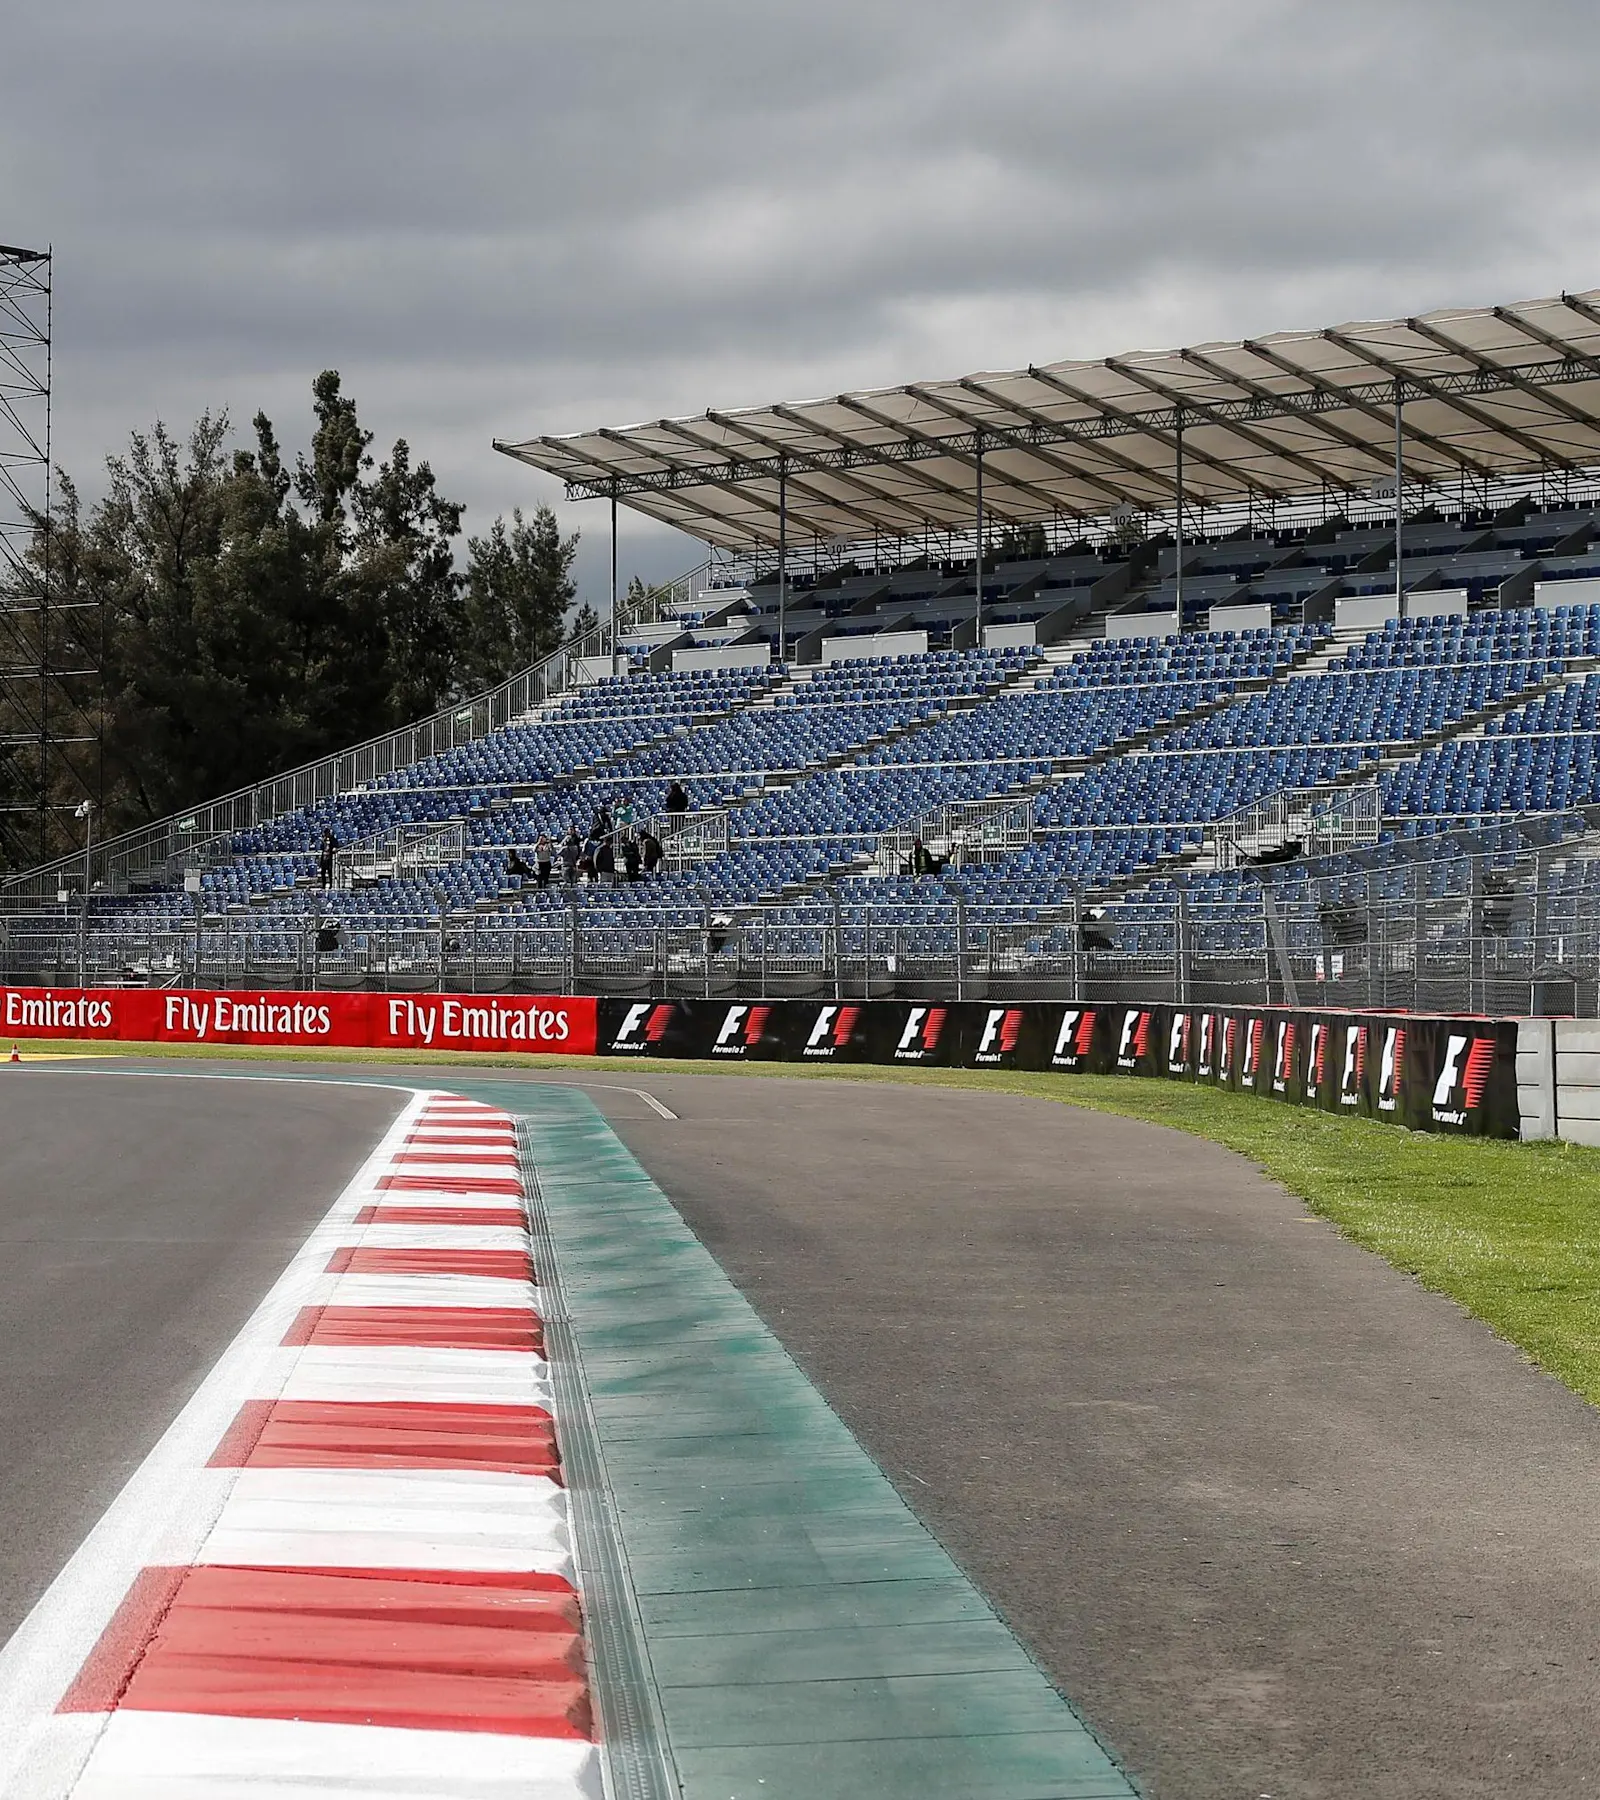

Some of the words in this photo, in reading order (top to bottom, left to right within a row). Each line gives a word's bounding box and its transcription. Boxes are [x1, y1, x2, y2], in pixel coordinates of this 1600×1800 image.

[6, 990, 112, 1028] Emirates
[166, 996, 209, 1038] Fly
[215, 996, 330, 1034] Emirates
[389, 1000, 436, 1043] Fly
[443, 1000, 568, 1041] Emirates
